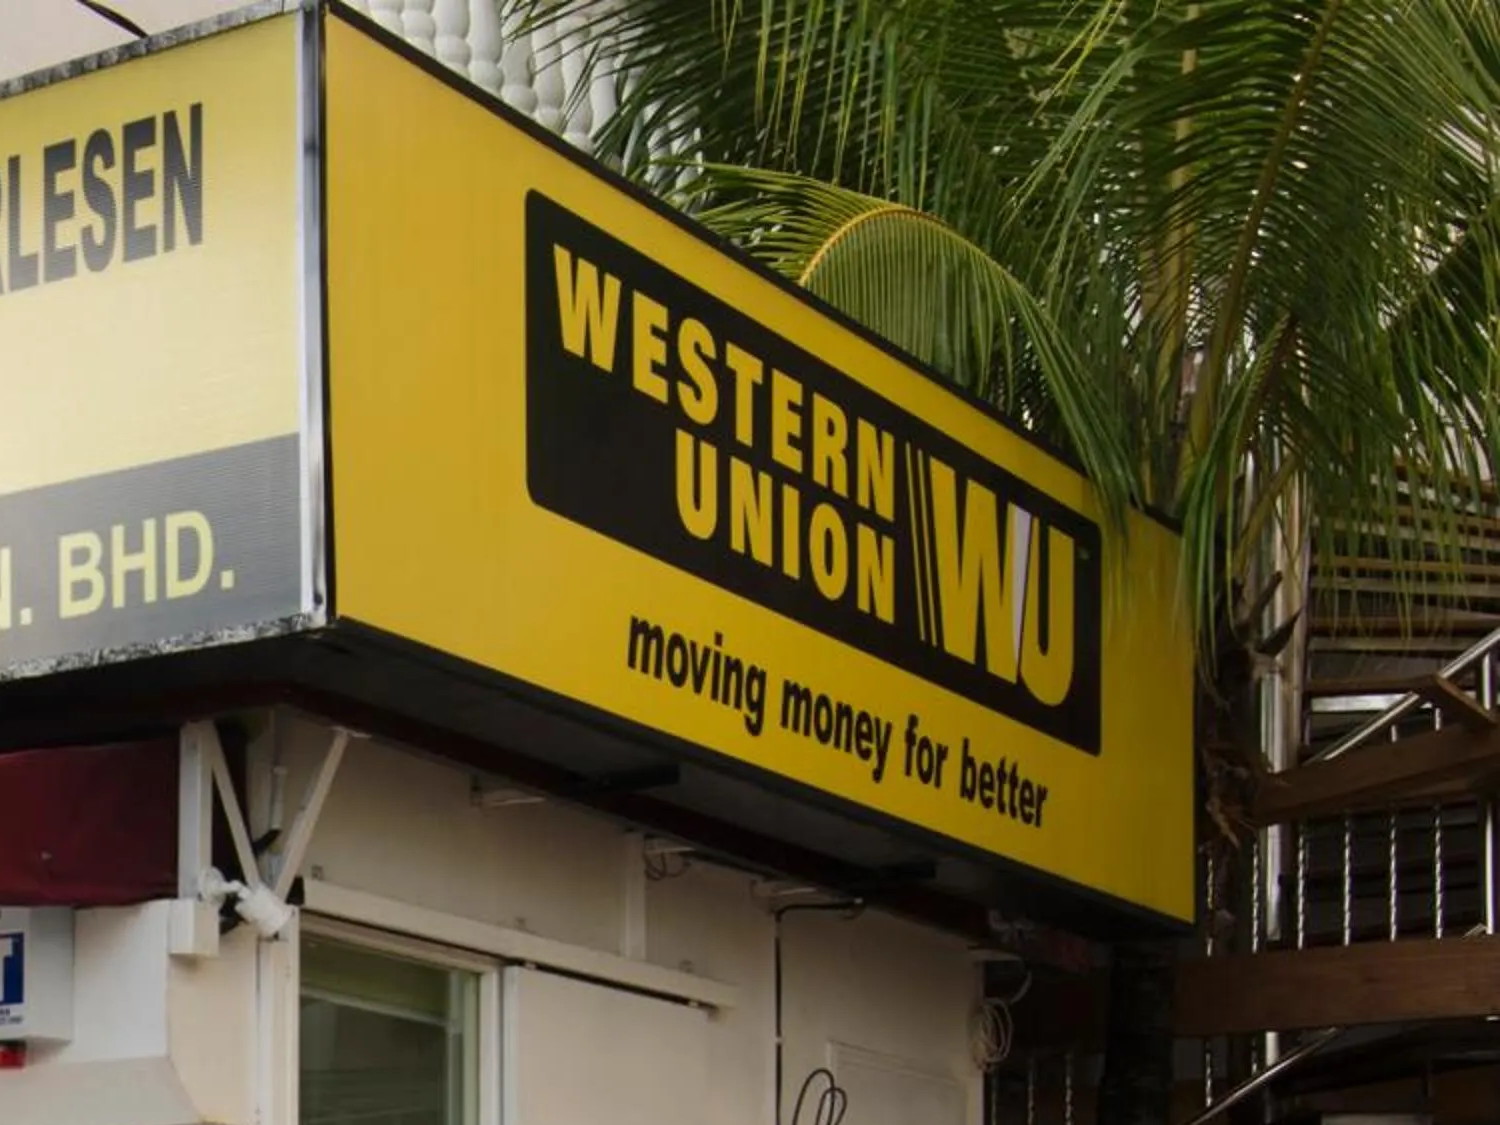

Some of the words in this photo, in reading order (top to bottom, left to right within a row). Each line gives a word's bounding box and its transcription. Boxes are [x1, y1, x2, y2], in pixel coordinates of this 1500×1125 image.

[553, 243, 895, 523] WESTERN
[59, 510, 237, 620] BHD.
[675, 428, 895, 626] UNION
[929, 455, 1075, 707] WU
[627, 614, 767, 738] moving
[780, 675, 893, 784] money
[903, 713, 949, 789] for
[959, 737, 1049, 829] better
